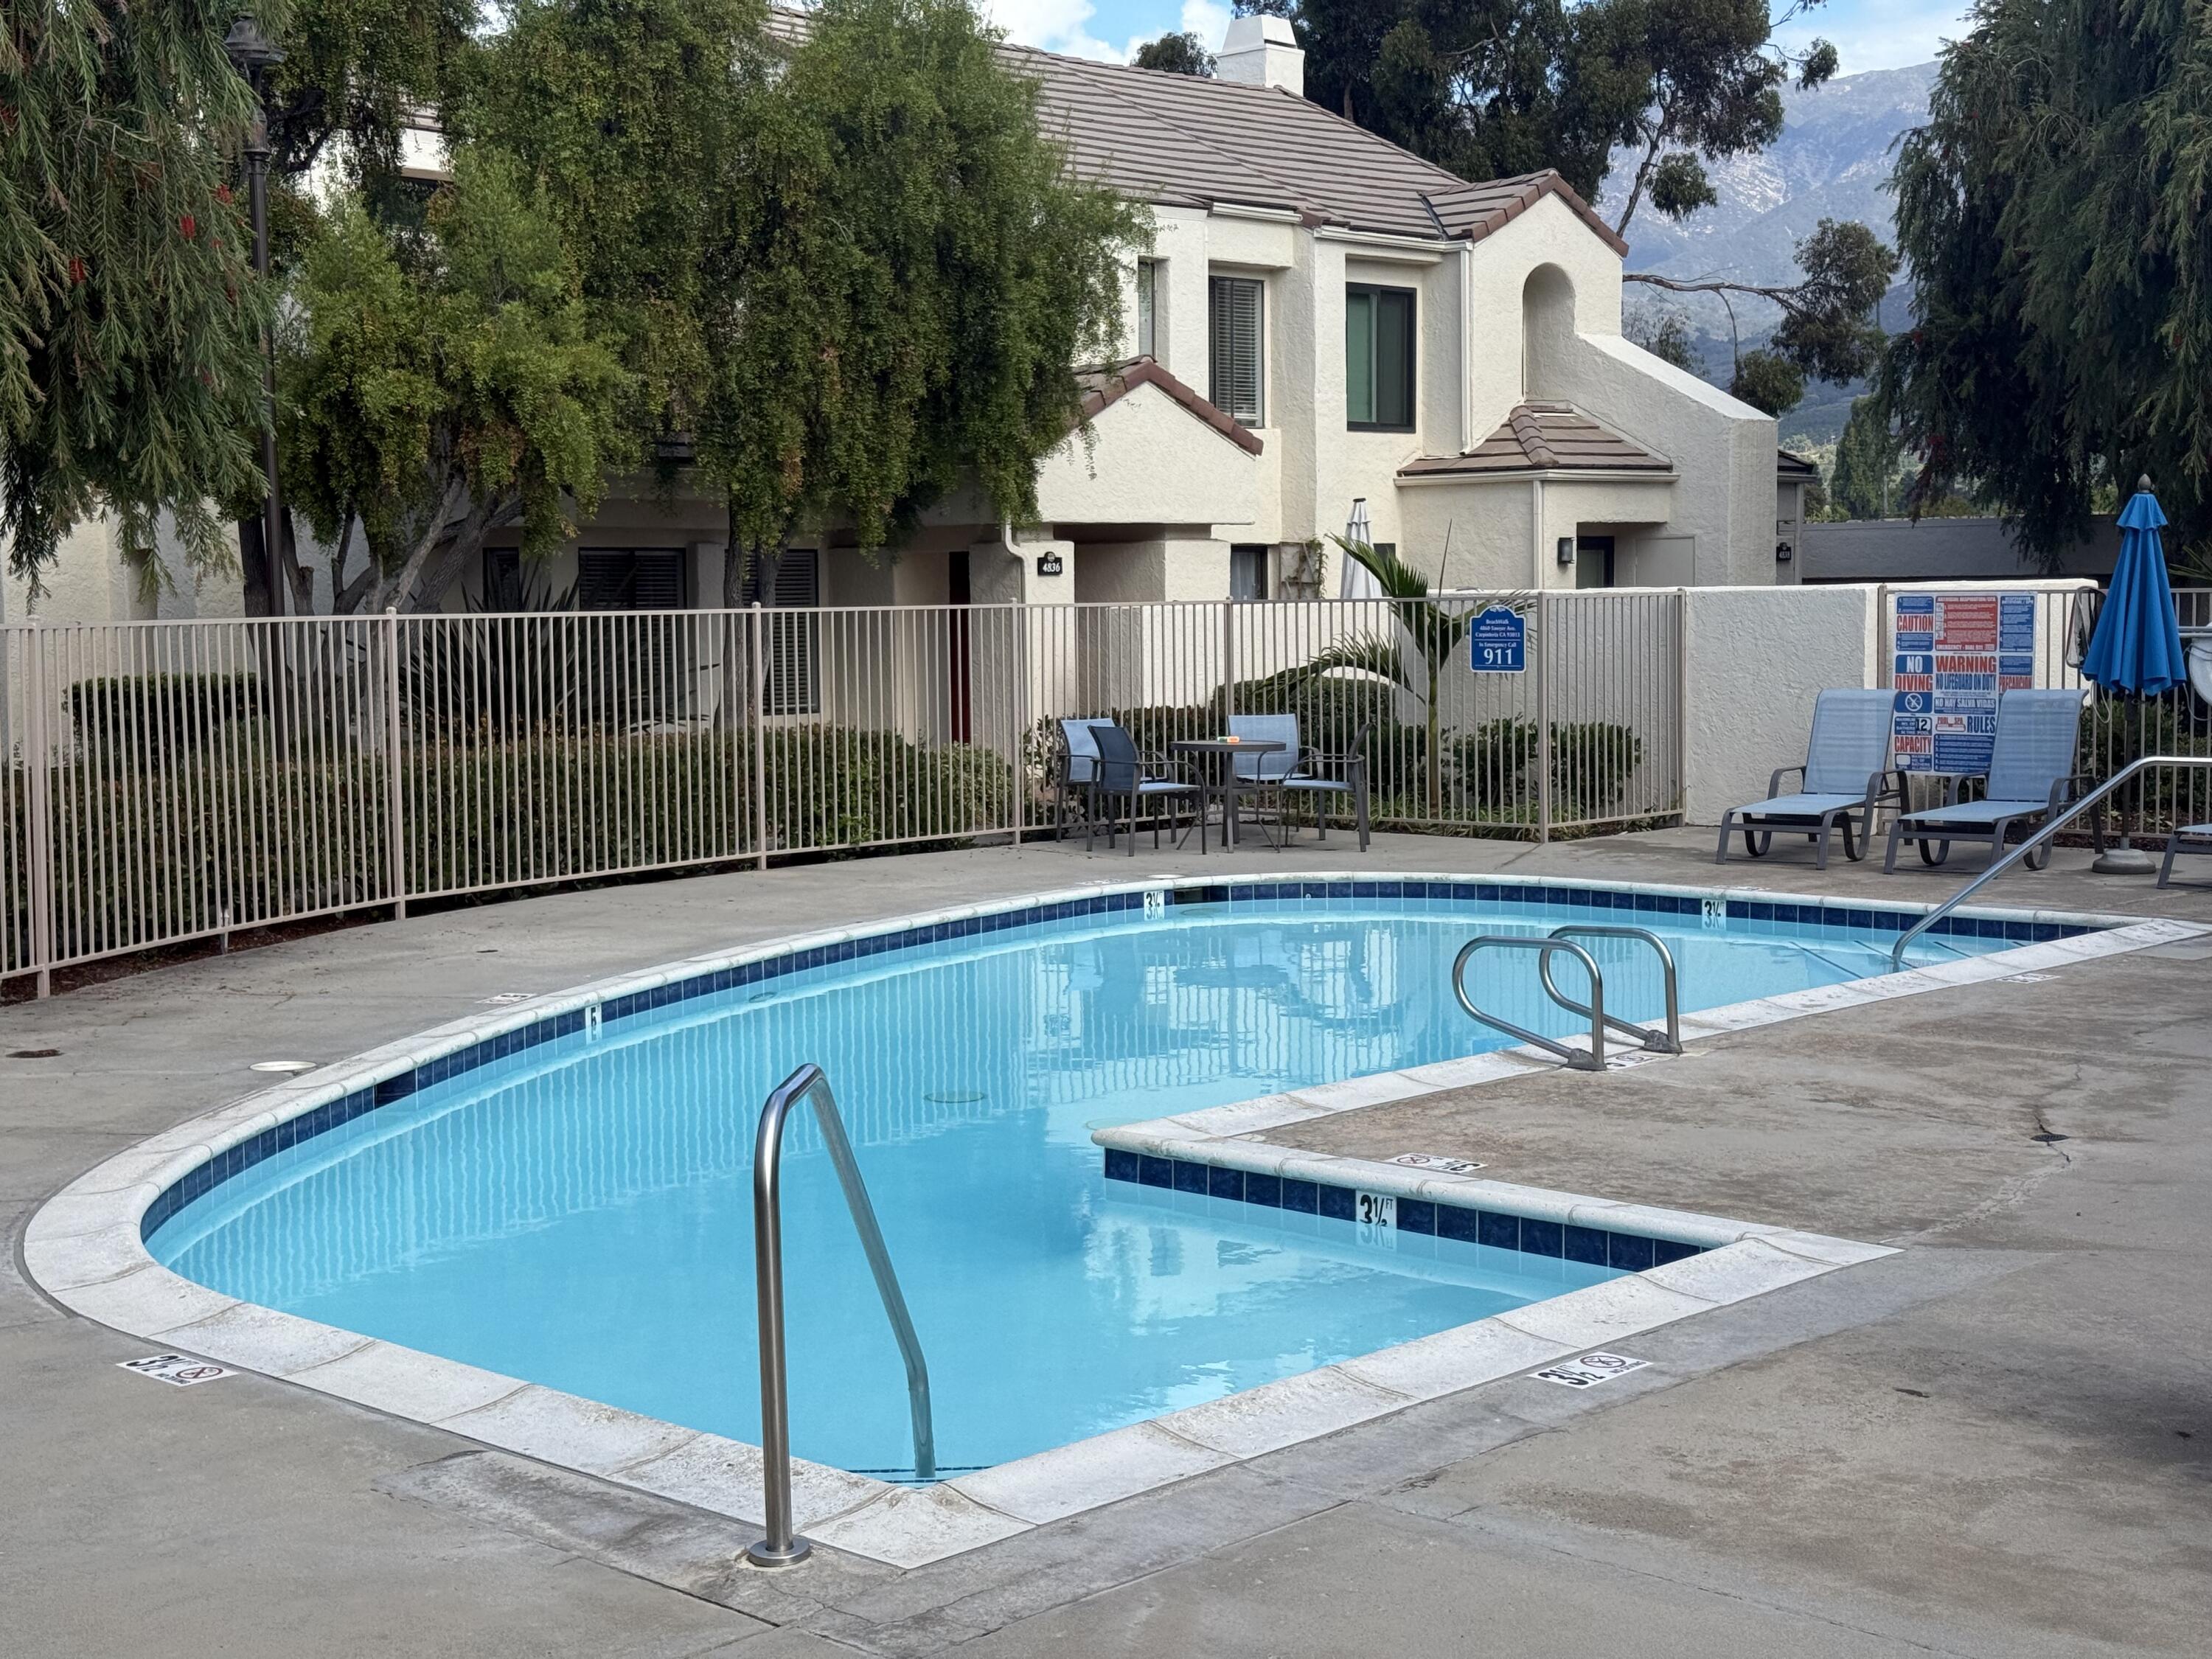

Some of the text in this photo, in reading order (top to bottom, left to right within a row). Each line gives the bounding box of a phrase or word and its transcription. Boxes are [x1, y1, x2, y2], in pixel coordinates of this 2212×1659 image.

[1042, 563, 1060, 572] 4836
[1896, 615, 1933, 631] CAUTION
[1484, 648, 1512, 664] 911
[1906, 655, 1923, 673] NO
[1935, 655, 1997, 673] WARNING
[1895, 675, 1933, 691] DIVING
[1935, 673, 1997, 691] NO LIFEGUARD ON DUTY
[1935, 698, 1995, 709] NO HAY SALVA VIDAS
[1916, 719, 1927, 731] 12
[1966, 716, 1996, 734] RULES
[1895, 737, 1932, 753] CAPACITY
[1385, 1198, 1394, 1210] FT
